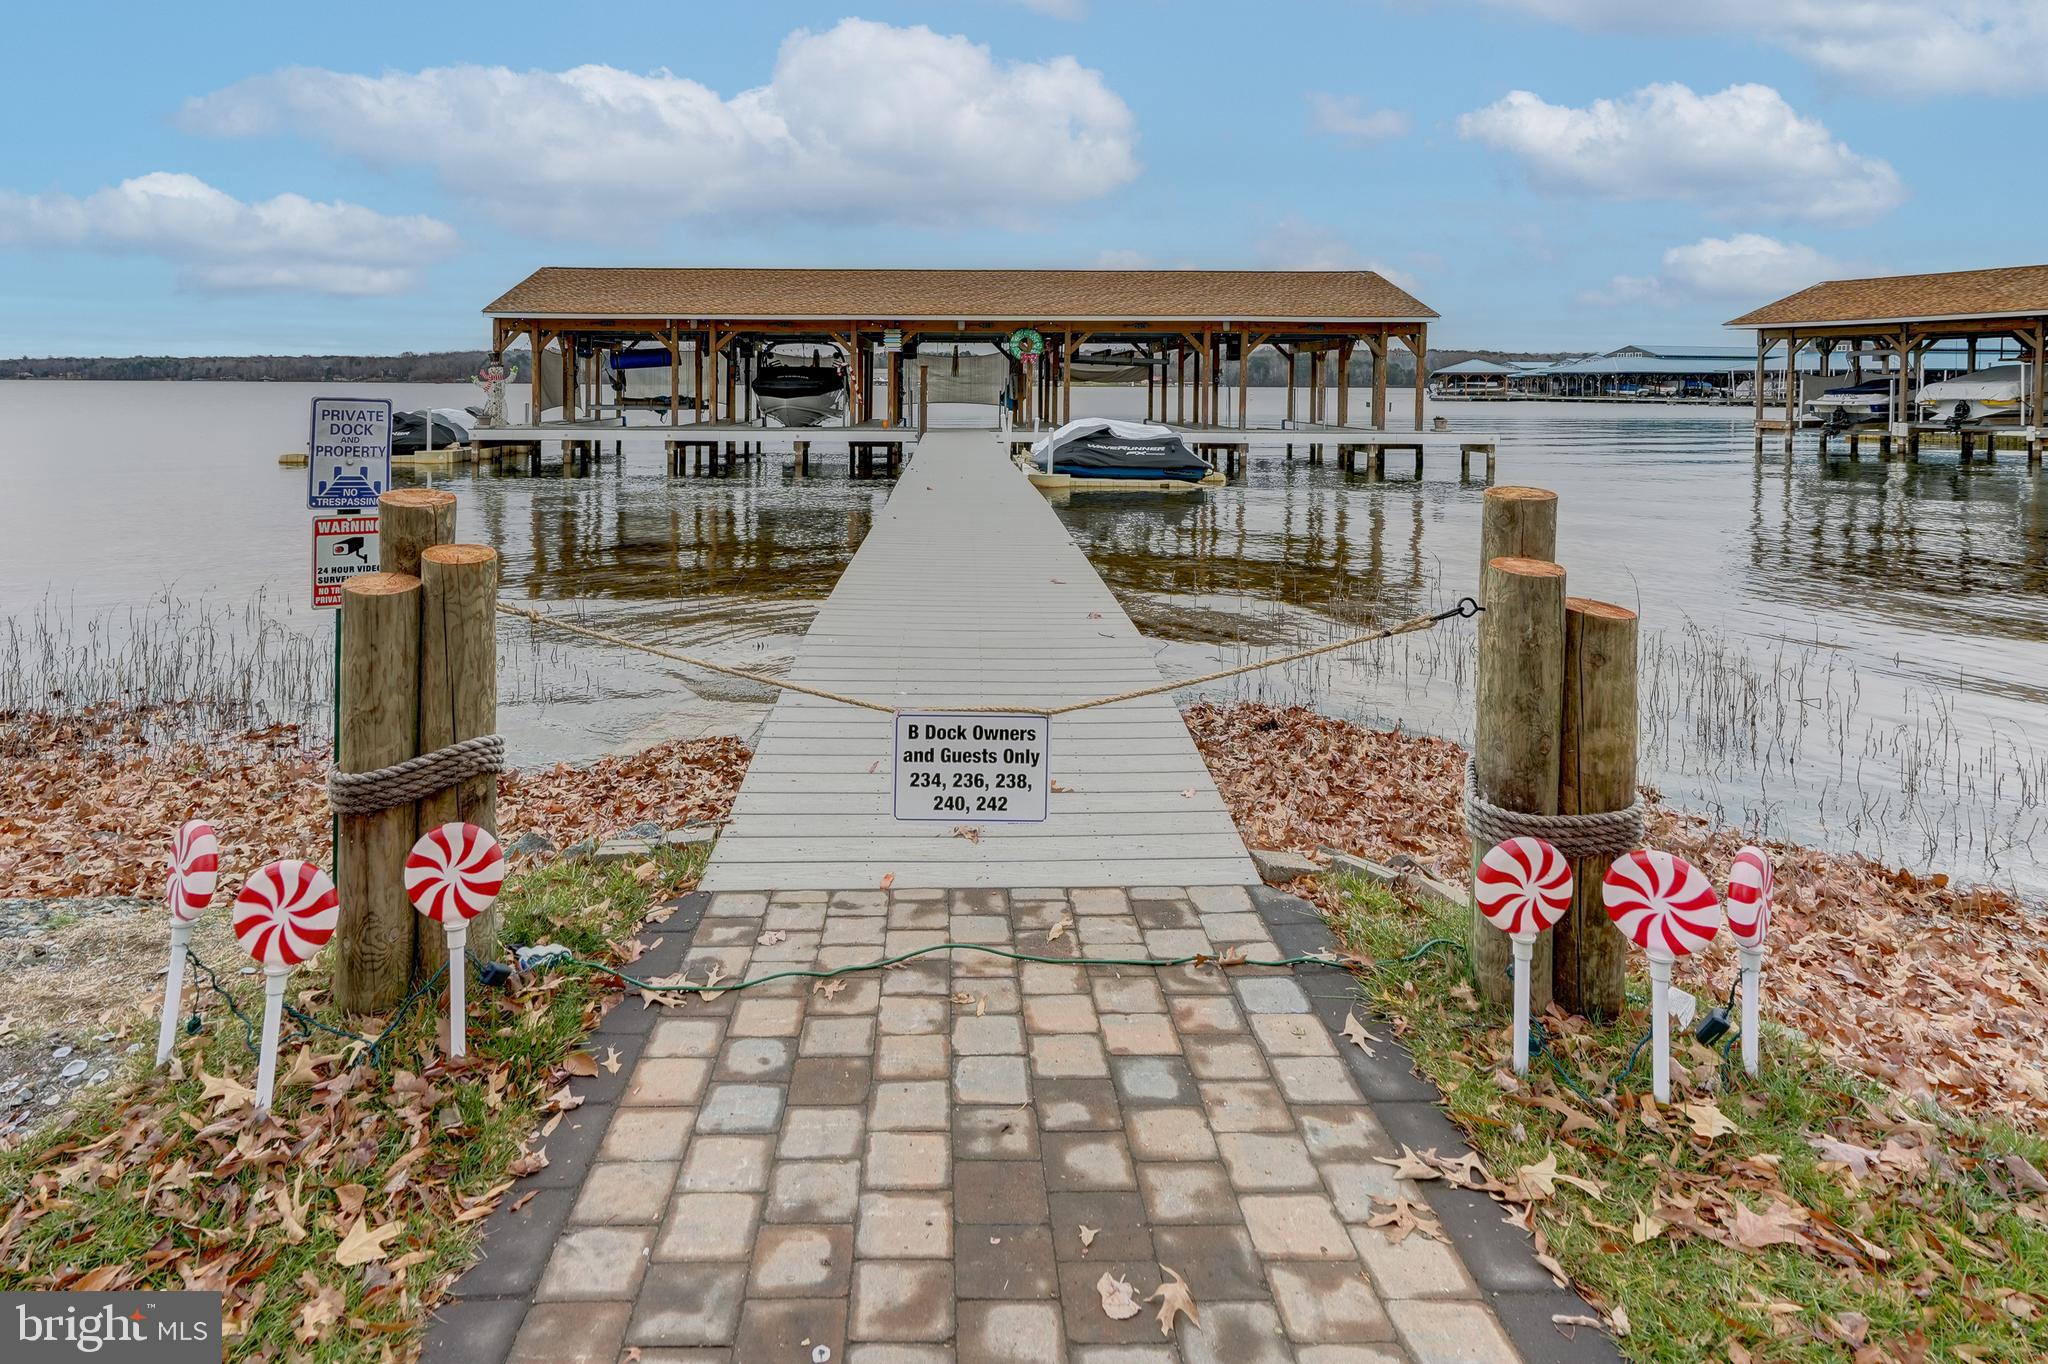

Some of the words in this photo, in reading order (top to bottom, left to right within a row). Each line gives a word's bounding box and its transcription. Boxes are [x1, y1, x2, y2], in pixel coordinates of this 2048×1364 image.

[321, 409, 385, 422] PRIVATE
[330, 423, 374, 436] DOCK
[340, 436, 360, 444] AND
[315, 445, 386, 458] PROPERTY
[343, 488, 358, 497] NO
[317, 567, 329, 575] 24
[331, 565, 355, 574] HOUR
[318, 587, 330, 595] NO
[908, 724, 919, 740] B
[925, 724, 968, 740] Dock
[972, 725, 1037, 741] Owners
[903, 747, 935, 763] and
[940, 747, 998, 764] Guests
[1003, 748, 1041, 767] Only
[909, 772, 947, 791] 234,
[952, 773, 990, 792] 236,
[995, 773, 1032, 792] 238,
[933, 795, 970, 814] 240,
[975, 796, 1009, 812] 242
